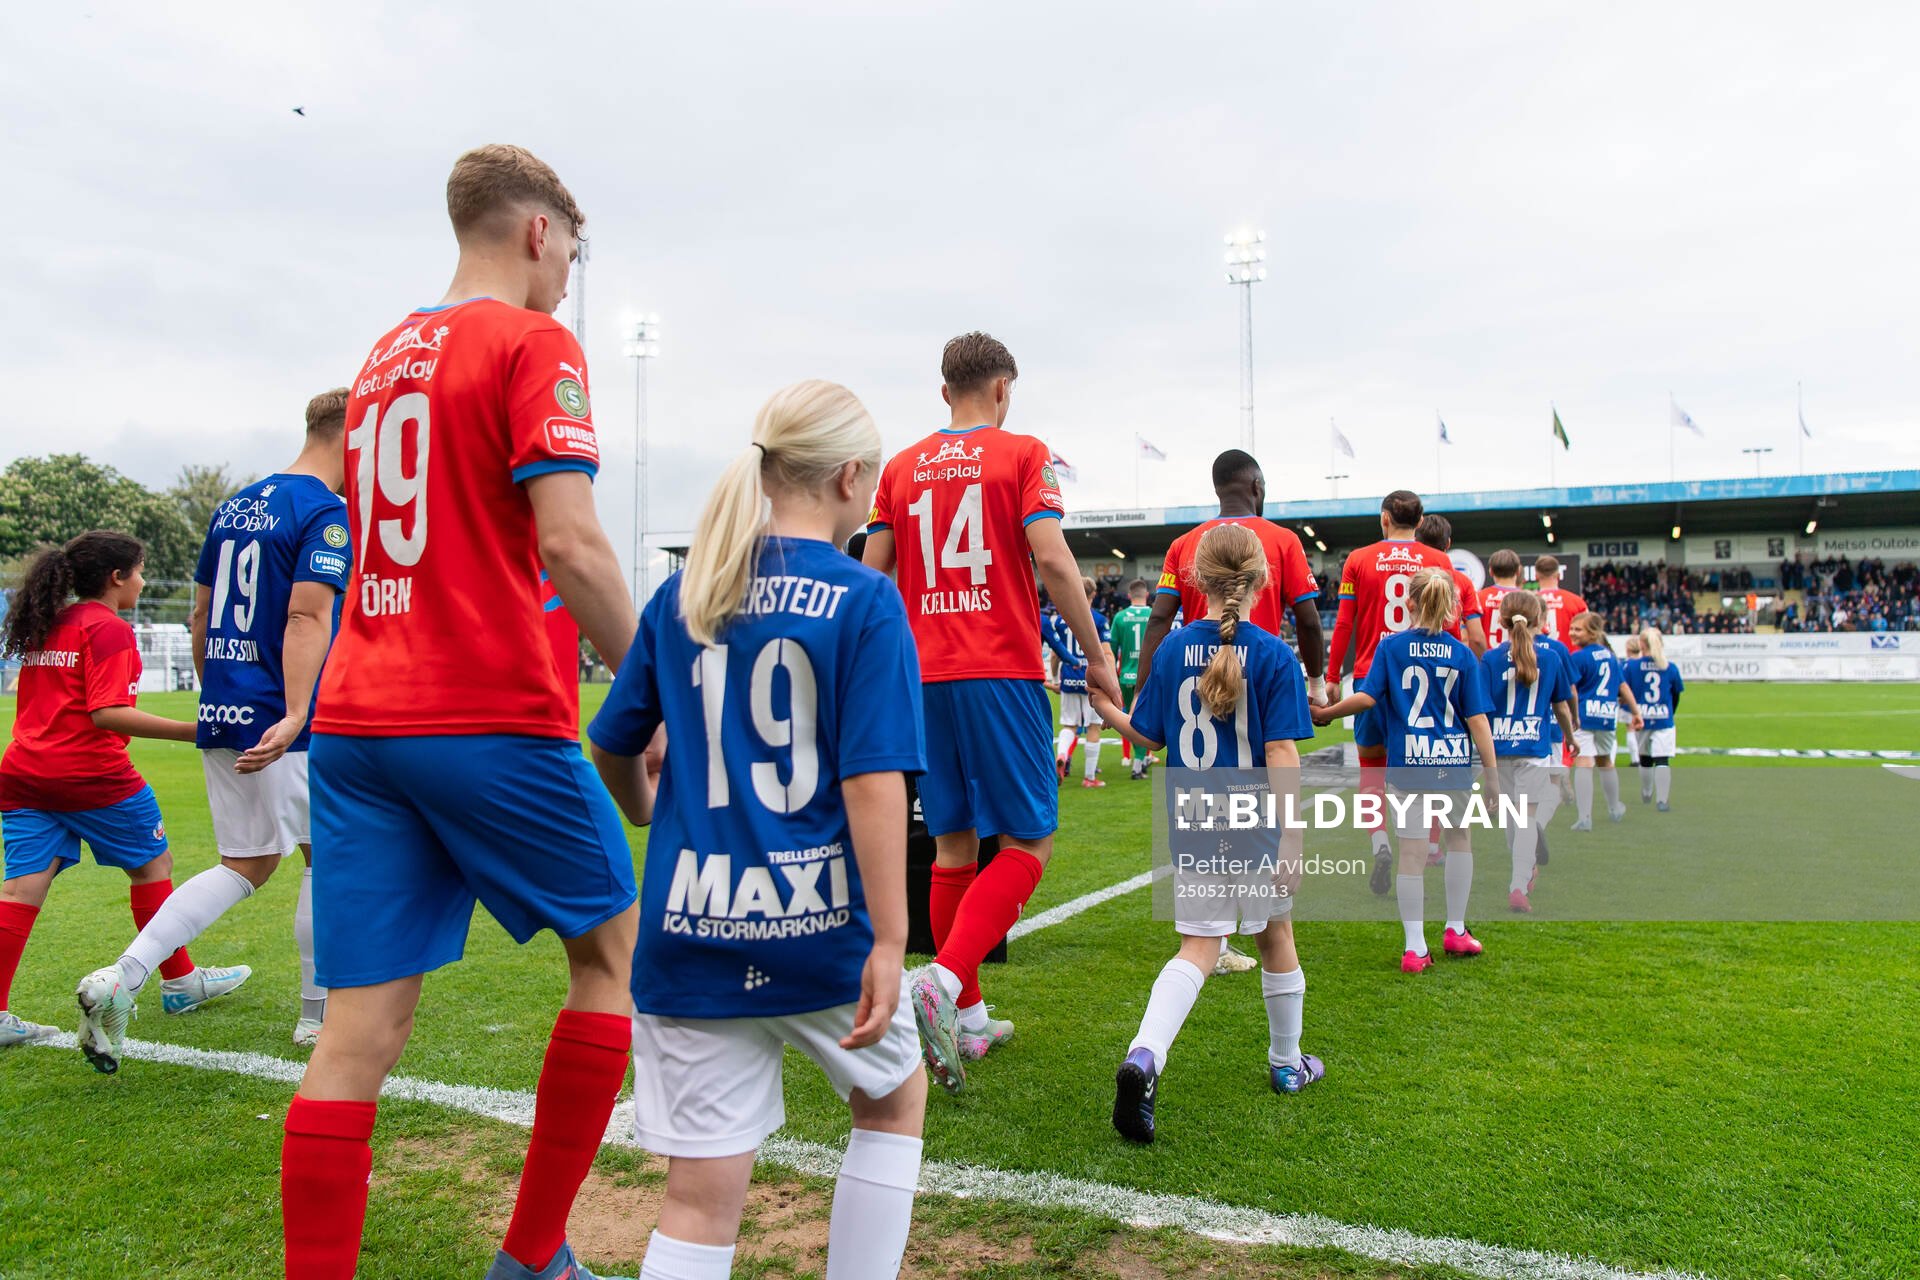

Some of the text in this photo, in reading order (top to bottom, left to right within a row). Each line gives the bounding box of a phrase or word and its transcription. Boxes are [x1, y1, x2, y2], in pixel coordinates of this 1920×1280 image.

[355, 357, 439, 399] letusplay
[551, 425, 598, 447] UNIBE
[348, 392, 431, 573] 19
[913, 464, 982, 483] letusplay
[908, 482, 993, 589] 14
[211, 539, 260, 633] 19
[361, 573, 412, 617] ÖRN
[921, 587, 992, 616] KJELLNÄS
[67, 651, 80, 668] IF
[1409, 642, 1452, 659] OLSSON
[1596, 661, 1611, 697] 2
[1644, 671, 1661, 704] 3
[1402, 665, 1459, 728] 27
[692, 638, 819, 814] 19
[1179, 675, 1254, 771] 81
[1405, 734, 1471, 758] MAXI
[1226, 782, 1271, 793] TRELLEBORG
[767, 843, 844, 864] TRELLEBORG
[666, 848, 850, 918] MAXI
[663, 909, 850, 940] ICA STORMARKNAD
